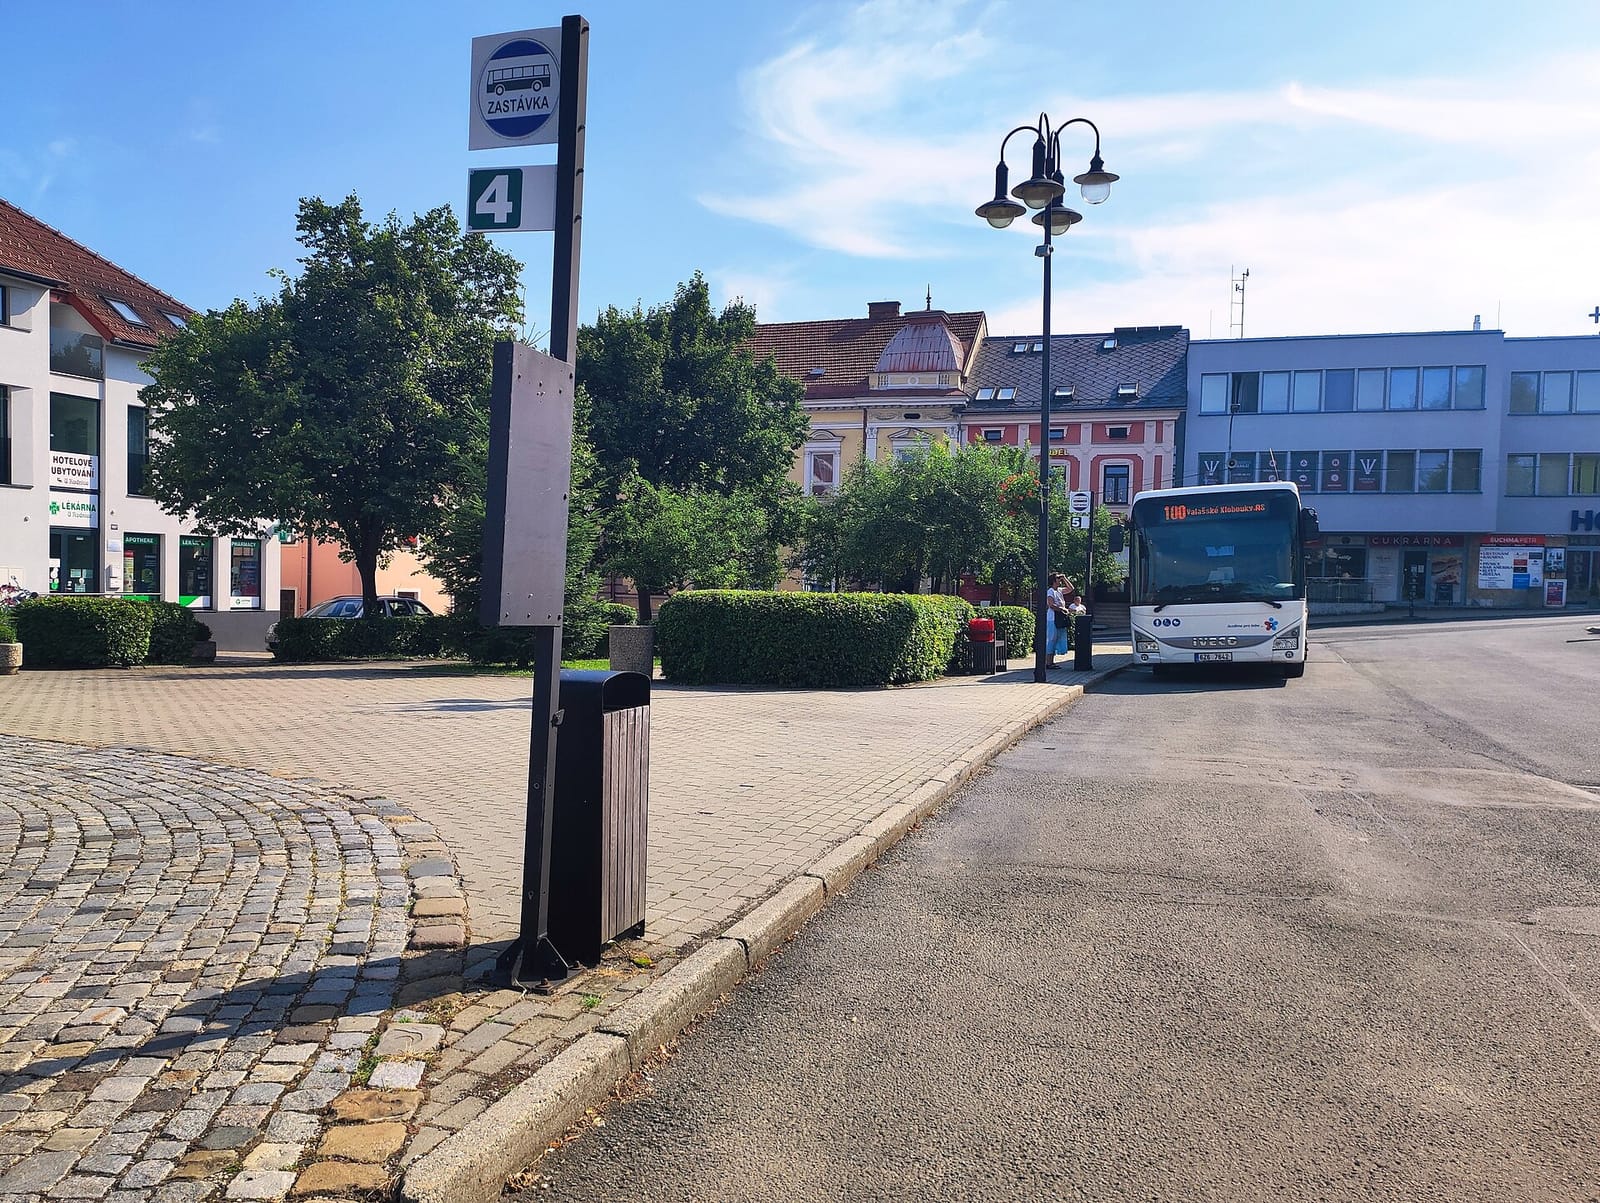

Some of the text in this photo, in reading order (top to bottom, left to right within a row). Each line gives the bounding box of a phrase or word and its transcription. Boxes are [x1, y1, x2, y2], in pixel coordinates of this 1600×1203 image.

[488, 95, 549, 114] ZASTÁVKA
[475, 174, 513, 223] 4
[53, 456, 92, 467] HOTELOVÉ
[51, 467, 95, 478] UBYTOVÁNÍ
[1164, 505, 1186, 520] 100
[1071, 517, 1080, 527] 5
[1571, 510, 1600, 531] H
[1193, 637, 1237, 646] IVECO
